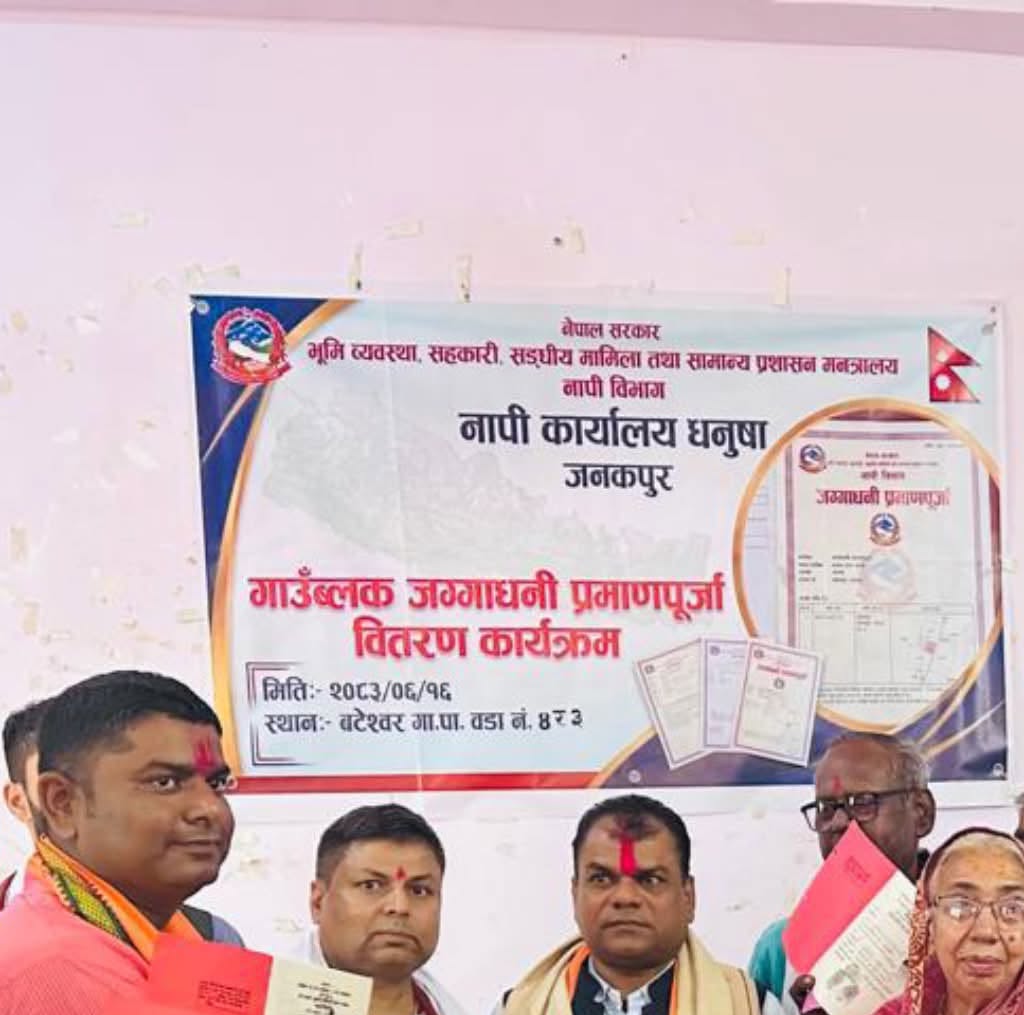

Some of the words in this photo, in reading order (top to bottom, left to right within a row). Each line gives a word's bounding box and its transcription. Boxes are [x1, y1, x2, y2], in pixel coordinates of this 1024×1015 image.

[561, 316, 603, 339] नेपाल
[609, 322, 661, 341] सरकार
[307, 336, 345, 366] भूमि
[578, 344, 641, 369] मामिला
[647, 351, 680, 370] तथा
[687, 352, 750, 372] सामान्य
[756, 354, 816, 375] प्रशासन
[562, 374, 603, 398] नापी
[610, 374, 665, 400] विभाग
[458, 402, 531, 445] नापी
[540, 406, 678, 448] कार्यालय
[687, 417, 768, 458] धनुषा
[563, 462, 673, 498] जनकपुर
[248, 566, 394, 610] गाउँब्लक
[406, 569, 558, 610] जग्गाधनी
[569, 571, 726, 623] प्रमाणपूर्जा
[353, 615, 468, 660] वितरण
[478, 617, 621, 660] कार्यक्रम
[470, 711, 505, 732] वडा
